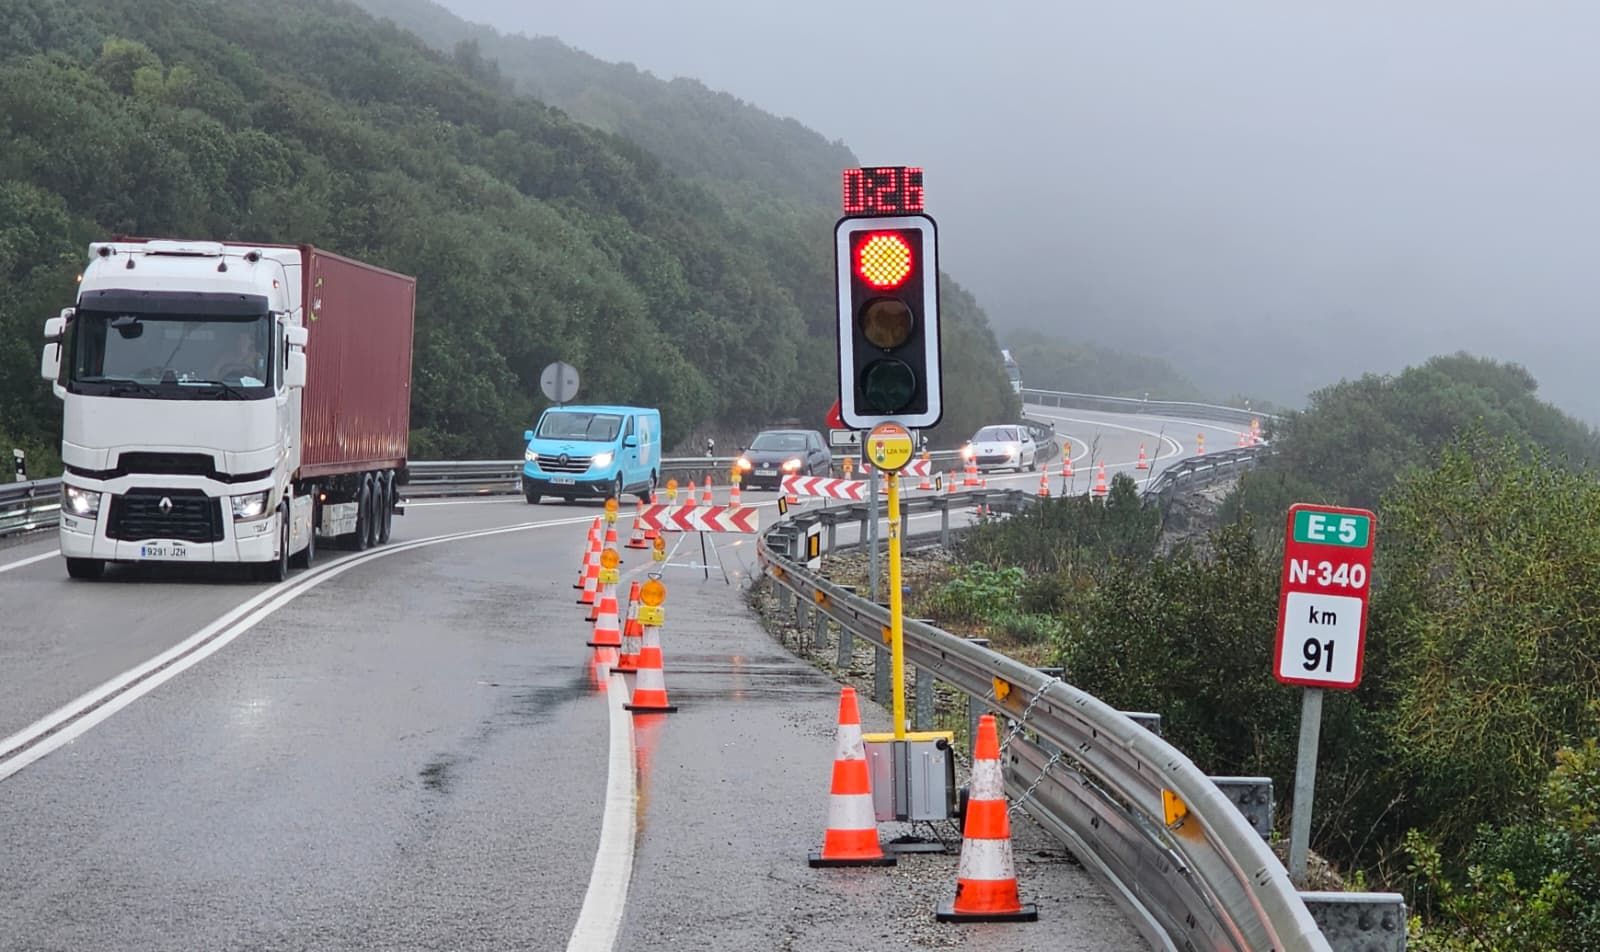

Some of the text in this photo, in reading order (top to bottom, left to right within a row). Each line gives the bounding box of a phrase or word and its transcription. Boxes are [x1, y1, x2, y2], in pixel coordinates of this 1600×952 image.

[843, 167, 924, 211] 0:26
[1307, 514, 1357, 543] E-5
[147, 547, 186, 557] 9291 JZH
[1289, 558, 1366, 589] N-340
[1308, 605, 1337, 625] km
[1302, 637, 1335, 673] 91
